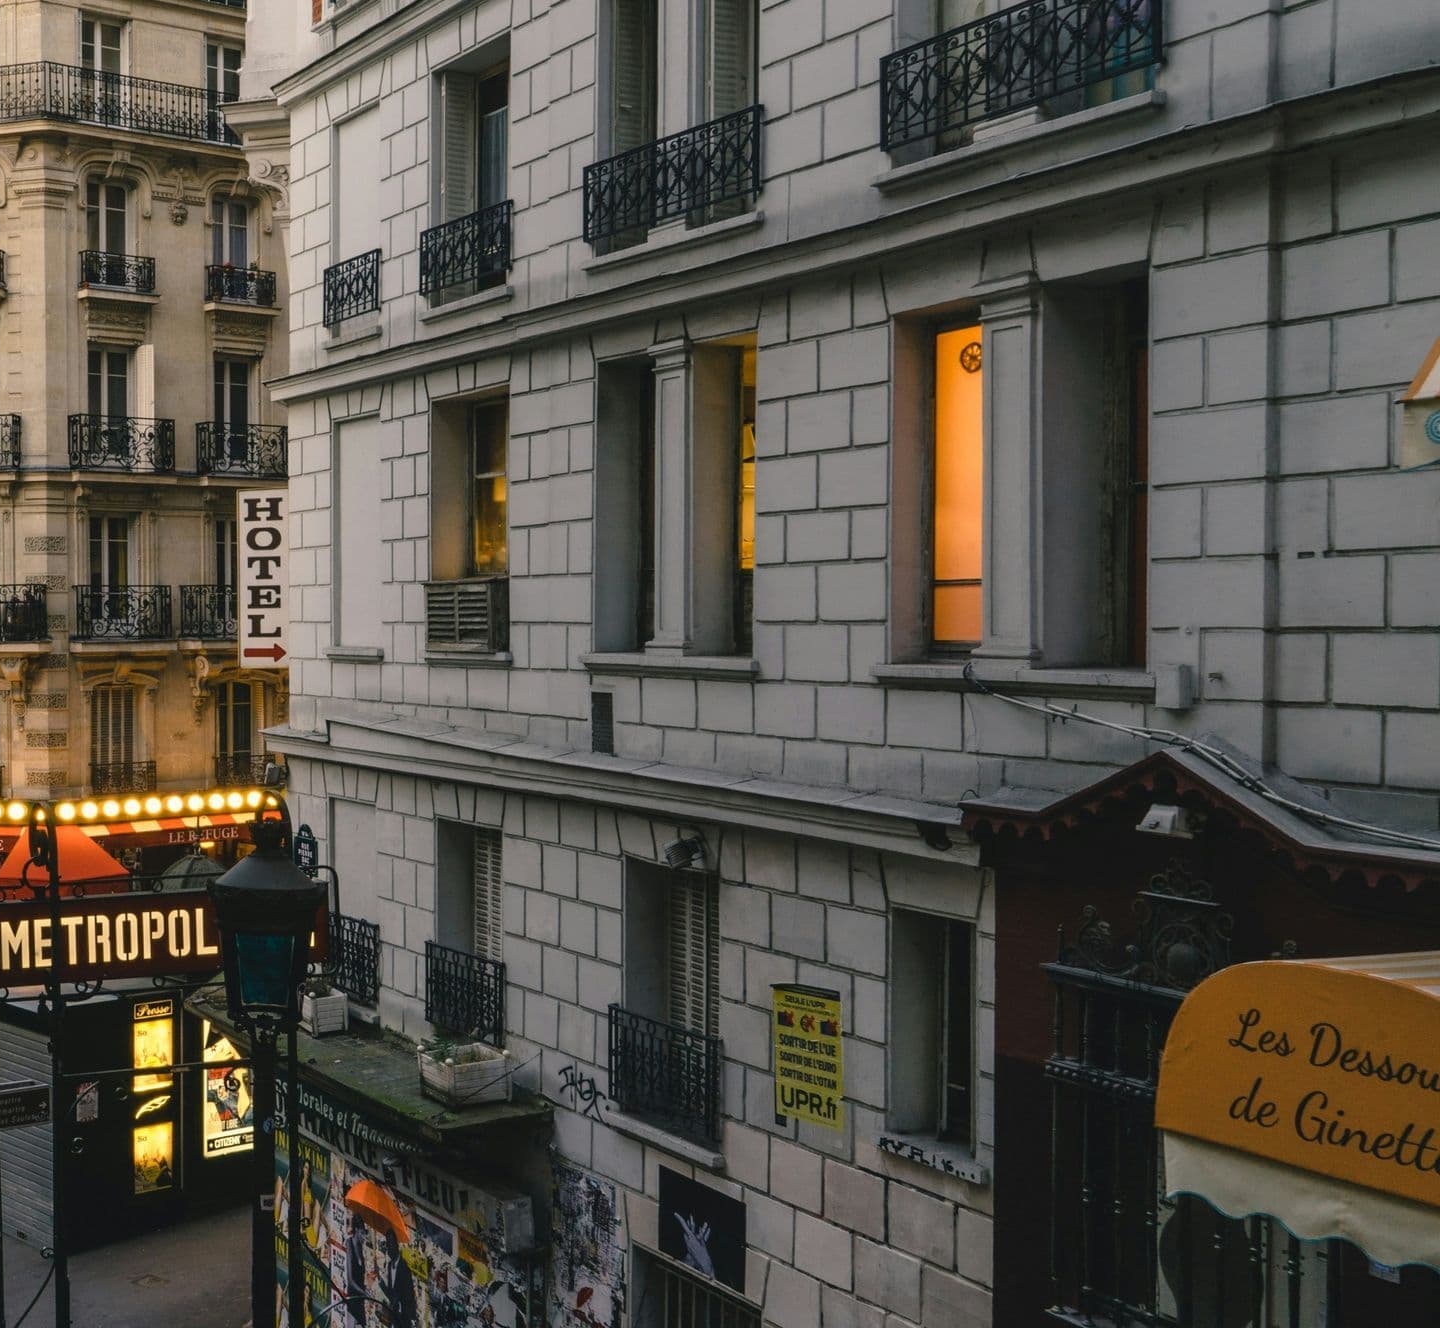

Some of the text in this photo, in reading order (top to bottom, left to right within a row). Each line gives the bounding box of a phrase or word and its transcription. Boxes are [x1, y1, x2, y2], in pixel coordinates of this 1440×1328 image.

[244, 496, 283, 639] HOTEL
[168, 831, 185, 843] LE
[0, 907, 315, 970] METROPOL
[136, 1003, 171, 1018] Presse
[779, 1033, 836, 1057] SORTIR DE L'UE
[1229, 1008, 1440, 1091] Les Dessou
[779, 1051, 837, 1074] SORTIR DE L'EURO
[780, 1067, 837, 1090] SORTIR DE L'OTAN
[780, 1085, 837, 1120] UPR.fr
[1230, 1079, 1440, 1174] de Ginett
